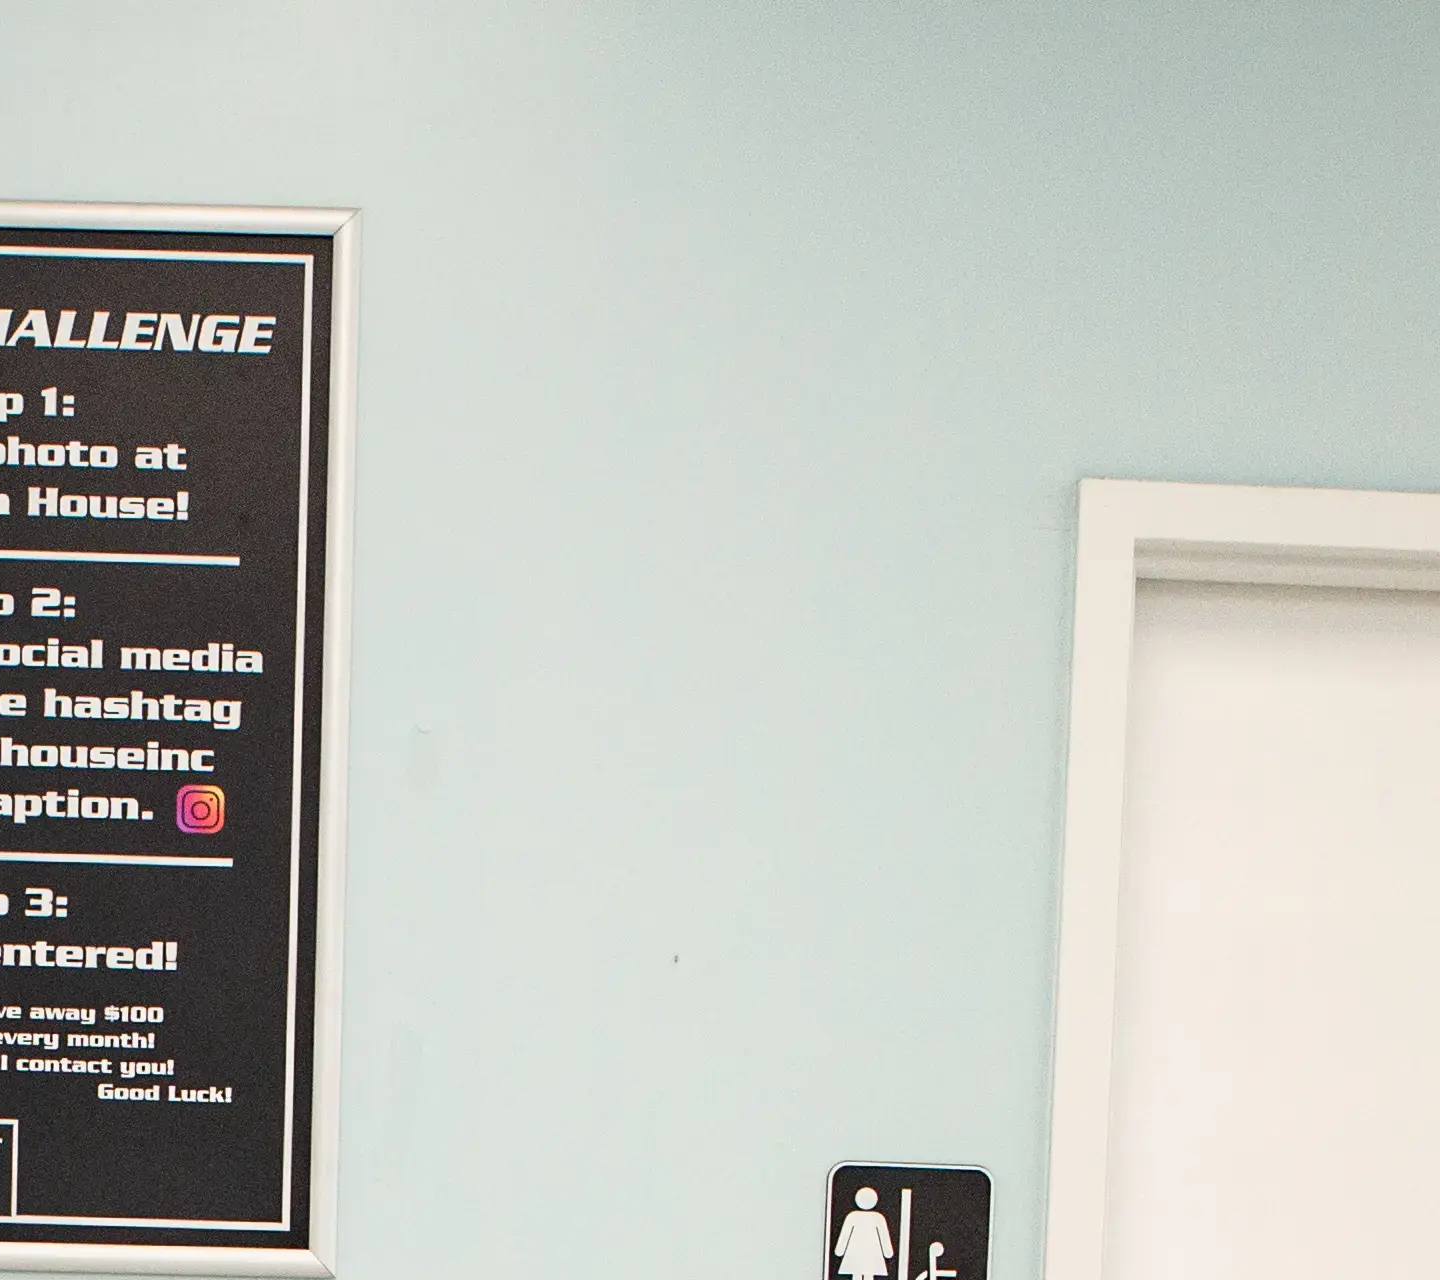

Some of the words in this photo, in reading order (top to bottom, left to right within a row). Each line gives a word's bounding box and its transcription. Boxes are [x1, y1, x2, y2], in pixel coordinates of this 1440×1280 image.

[41, 387, 74, 416] 1:
[135, 444, 187, 470] at
[28, 487, 188, 520] House!
[31, 588, 75, 617] 2:
[120, 643, 263, 673] media
[44, 688, 242, 729] hashtag
[25, 888, 67, 917] 3:
[30, 1007, 95, 1024] away
[105, 1005, 163, 1022] $100
[67, 1032, 155, 1048] month!
[16, 1058, 112, 1073] contact
[120, 1060, 174, 1078] you!
[98, 1084, 160, 1101] Good
[168, 1086, 232, 1103] Luck!
